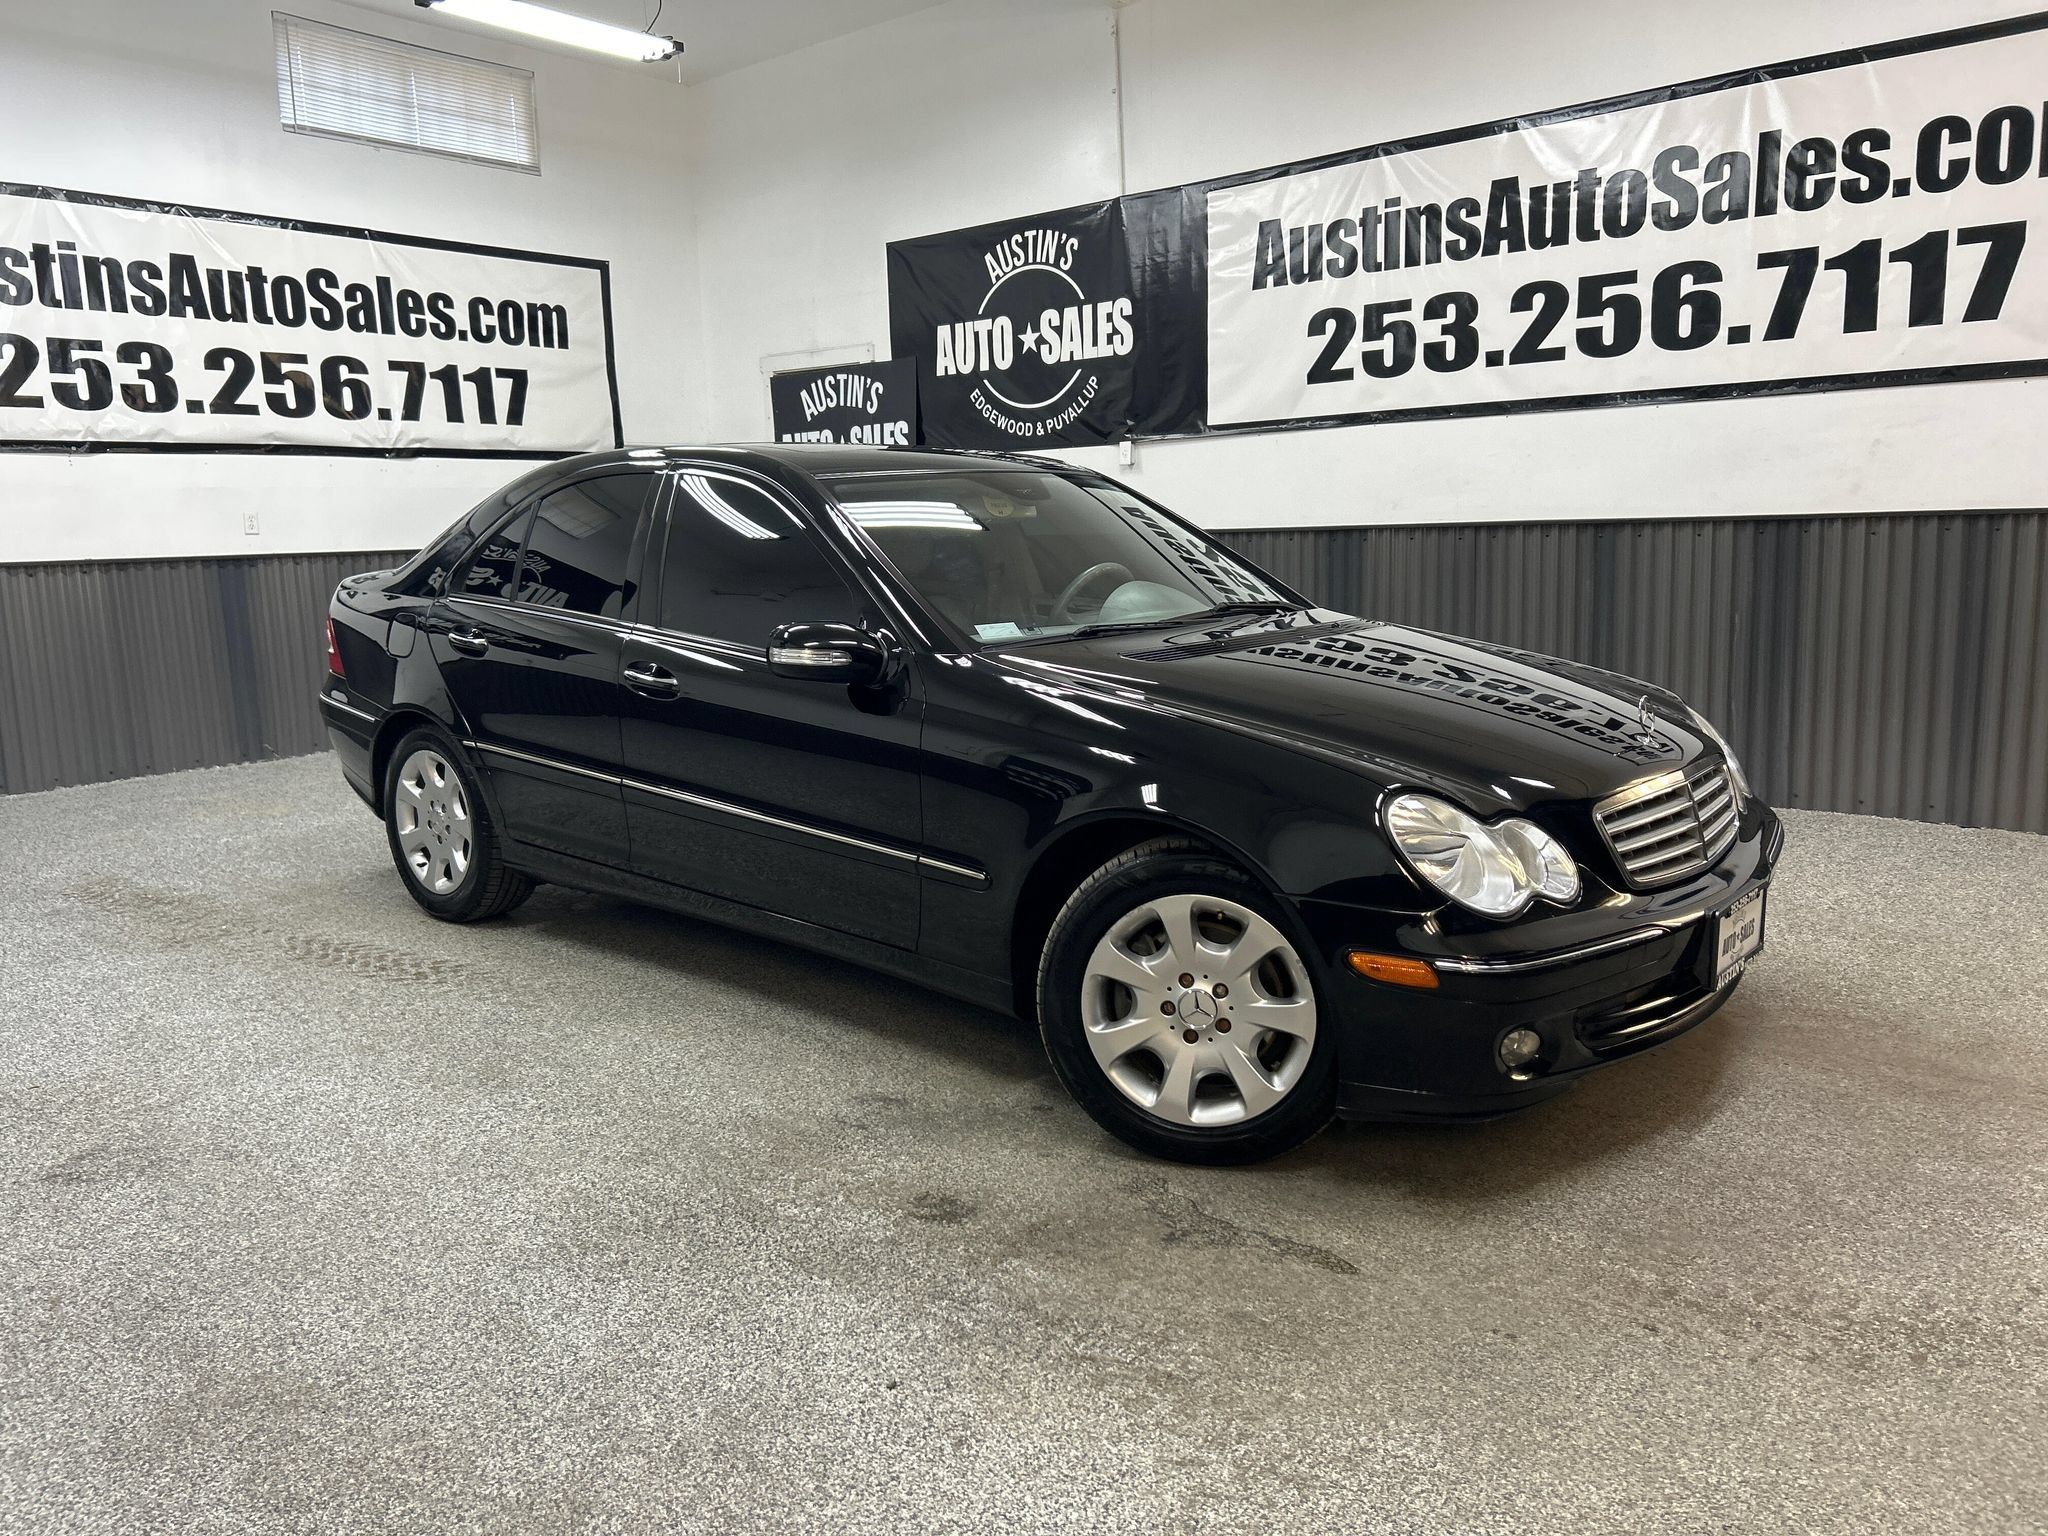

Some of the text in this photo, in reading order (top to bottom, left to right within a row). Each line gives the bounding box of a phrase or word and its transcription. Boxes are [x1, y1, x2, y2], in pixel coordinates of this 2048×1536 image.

[1251, 100, 2048, 291] AustinsAutoSales.co
[984, 229, 1079, 285] AUSTIN'S
[936, 297, 1134, 377] AUTO SALES
[1306, 220, 2027, 385] 253.256.7117
[0, 332, 529, 427] 253.256.7117
[800, 373, 884, 422] AUSTIN'S
[969, 375, 1099, 437] EDGEWOOD & PUYALLUP
[1721, 931, 1738, 957] AUTO
